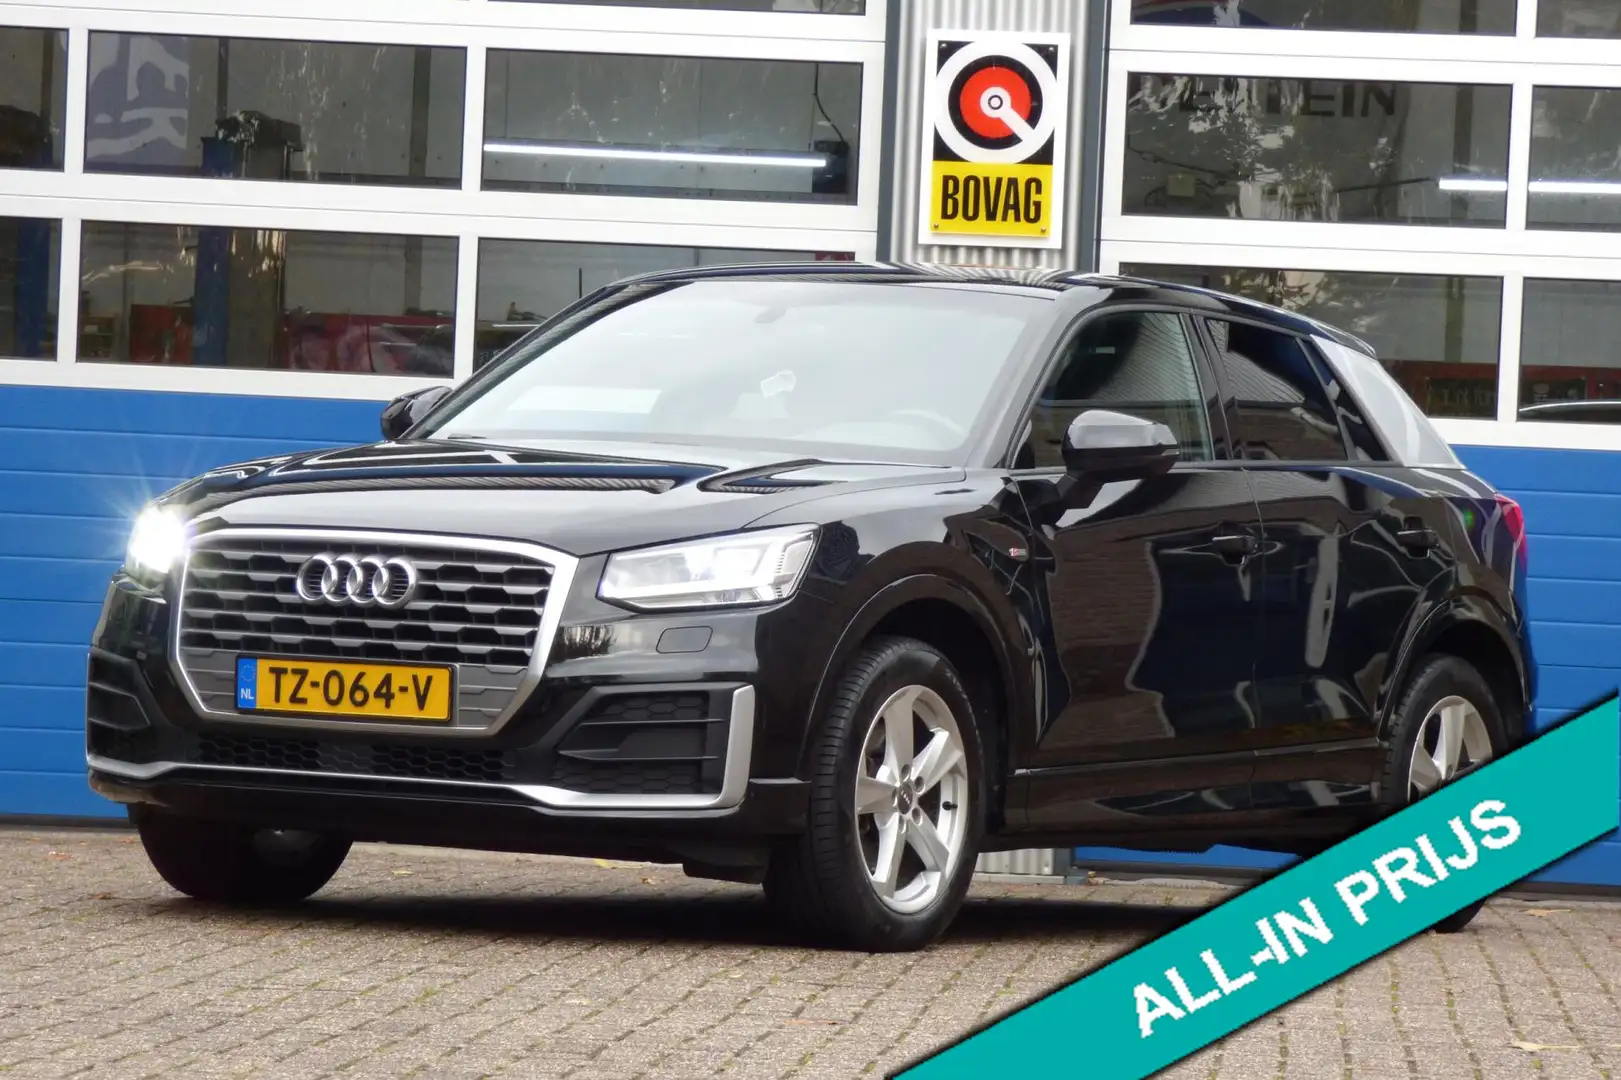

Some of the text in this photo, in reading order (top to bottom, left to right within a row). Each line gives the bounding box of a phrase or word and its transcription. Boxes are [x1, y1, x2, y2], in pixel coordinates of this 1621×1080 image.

[941, 175, 1042, 223] BOVAG
[240, 688, 255, 700] NL
[268, 667, 433, 711] TZ-064-V
